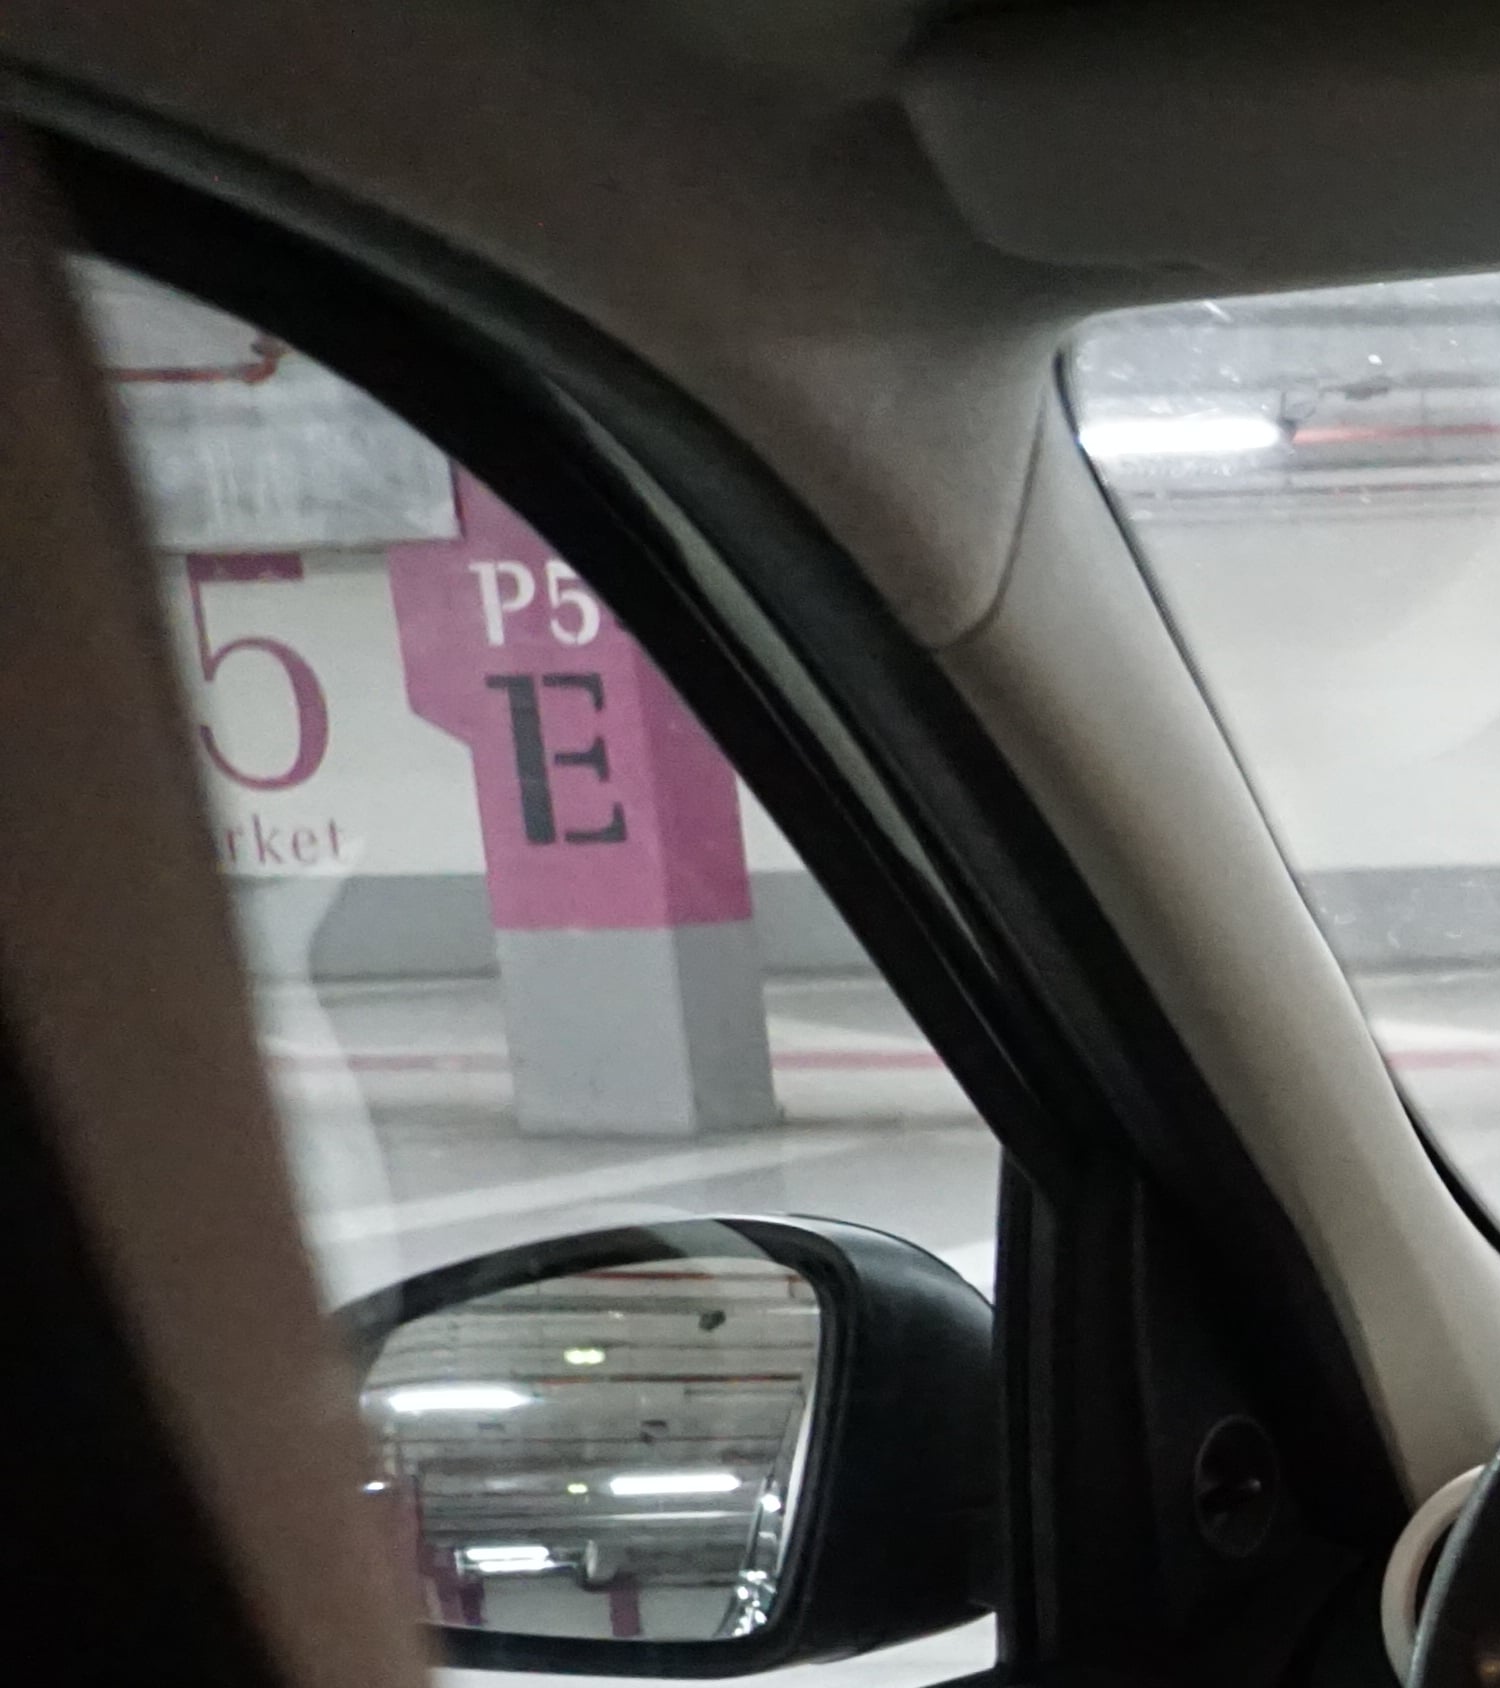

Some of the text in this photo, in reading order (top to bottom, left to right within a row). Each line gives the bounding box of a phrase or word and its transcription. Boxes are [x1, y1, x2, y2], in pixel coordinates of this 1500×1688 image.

[469, 561, 600, 647] P5
[186, 552, 330, 791] 5
[485, 672, 628, 846] E
[215, 813, 350, 867] rket
